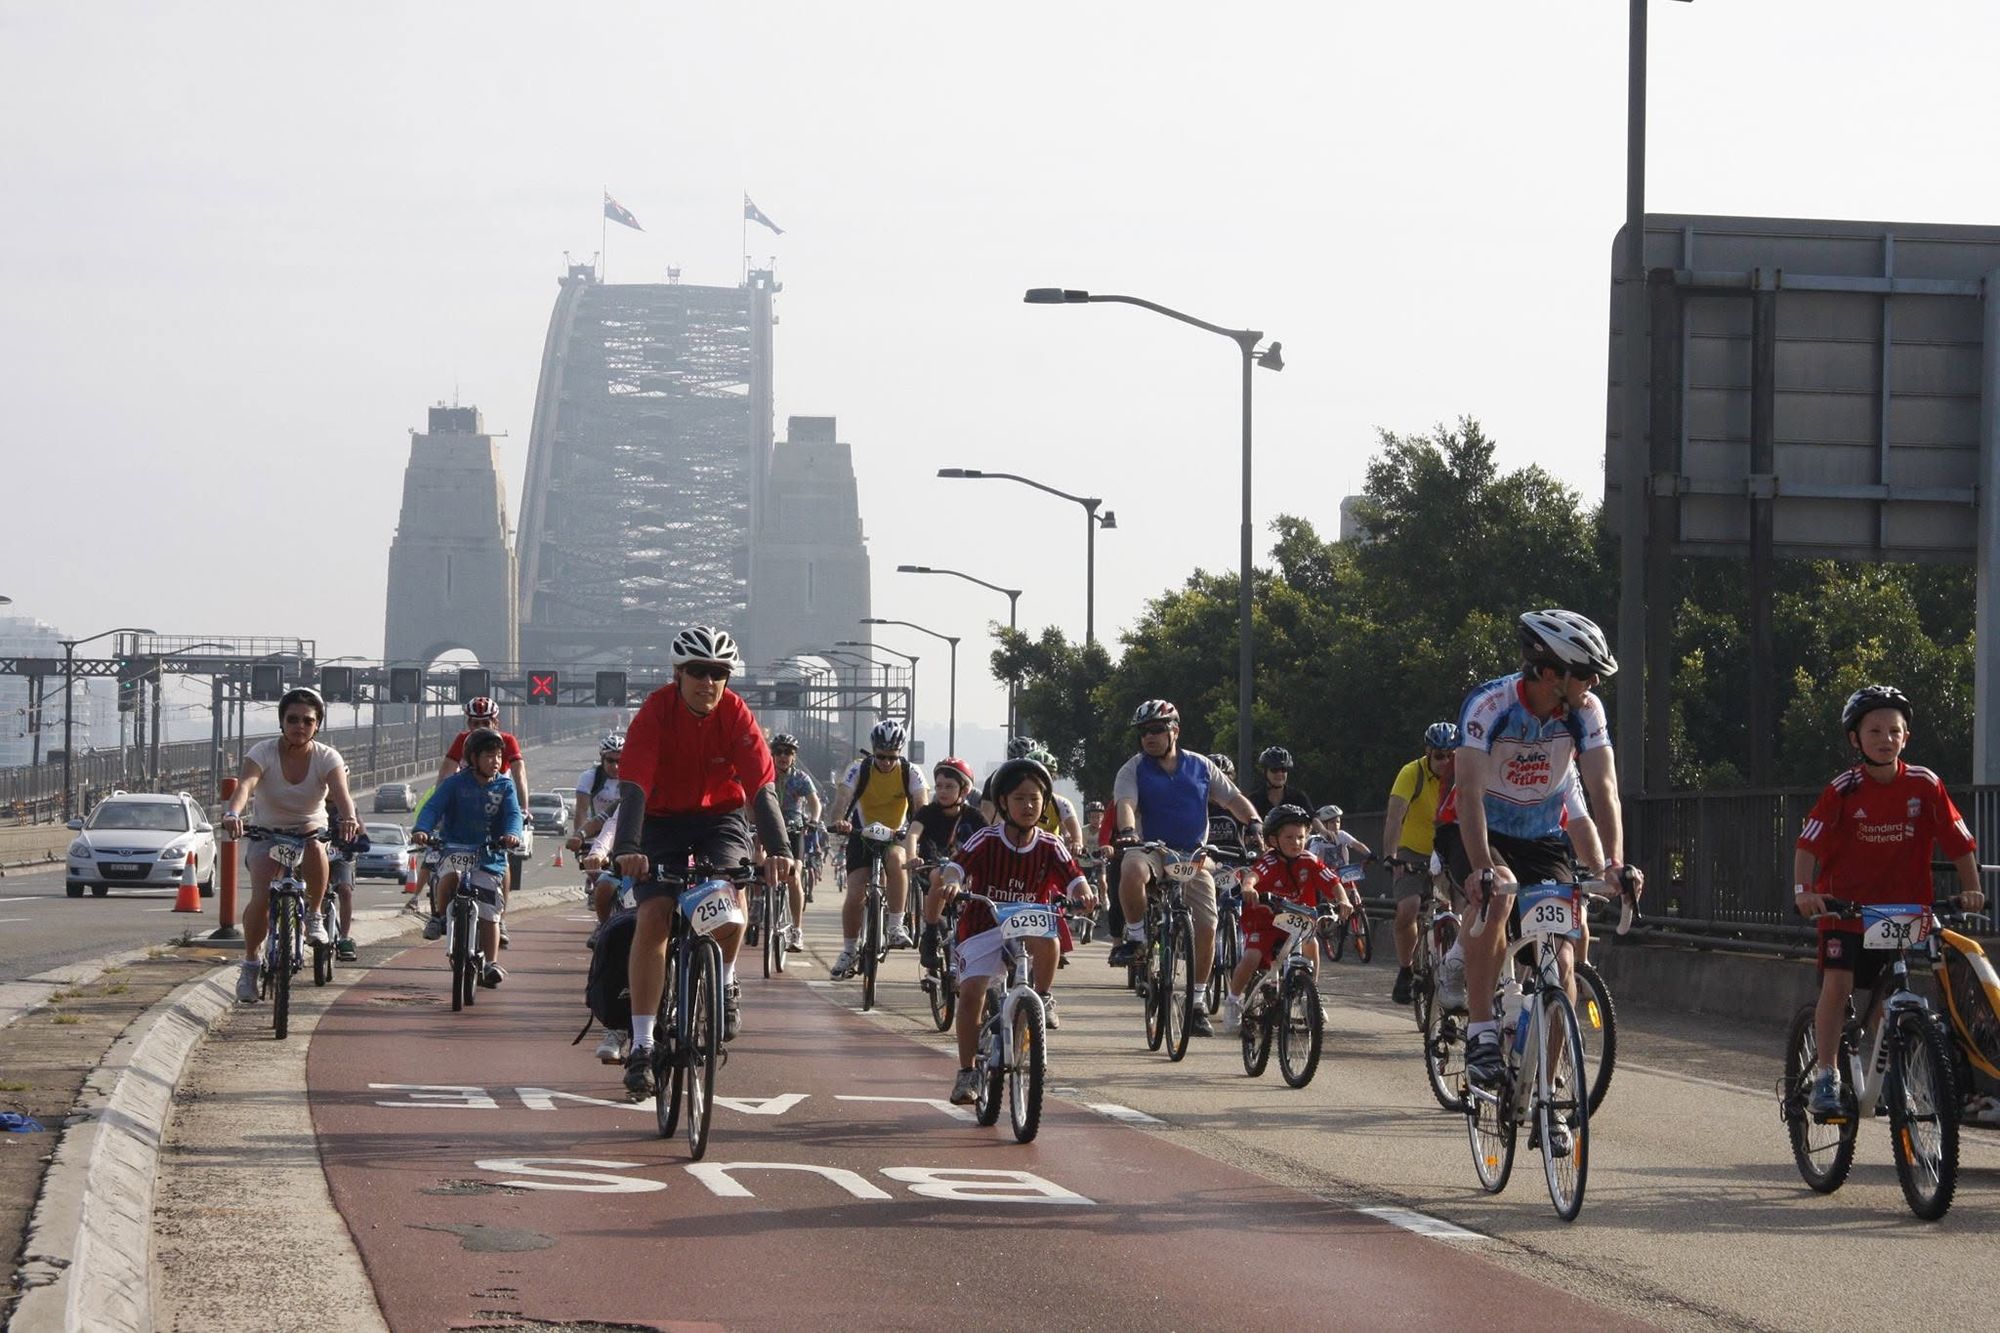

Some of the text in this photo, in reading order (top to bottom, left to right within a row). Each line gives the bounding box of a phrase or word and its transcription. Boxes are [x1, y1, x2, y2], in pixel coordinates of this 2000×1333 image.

[1859, 822, 1903, 833] Standard
[1857, 831, 1903, 843] Chartered
[1286, 914, 1309, 930] 334
[1535, 905, 1564, 923] 335
[1881, 922, 1911, 939] 338
[474, 1157, 1099, 1205] BUS
